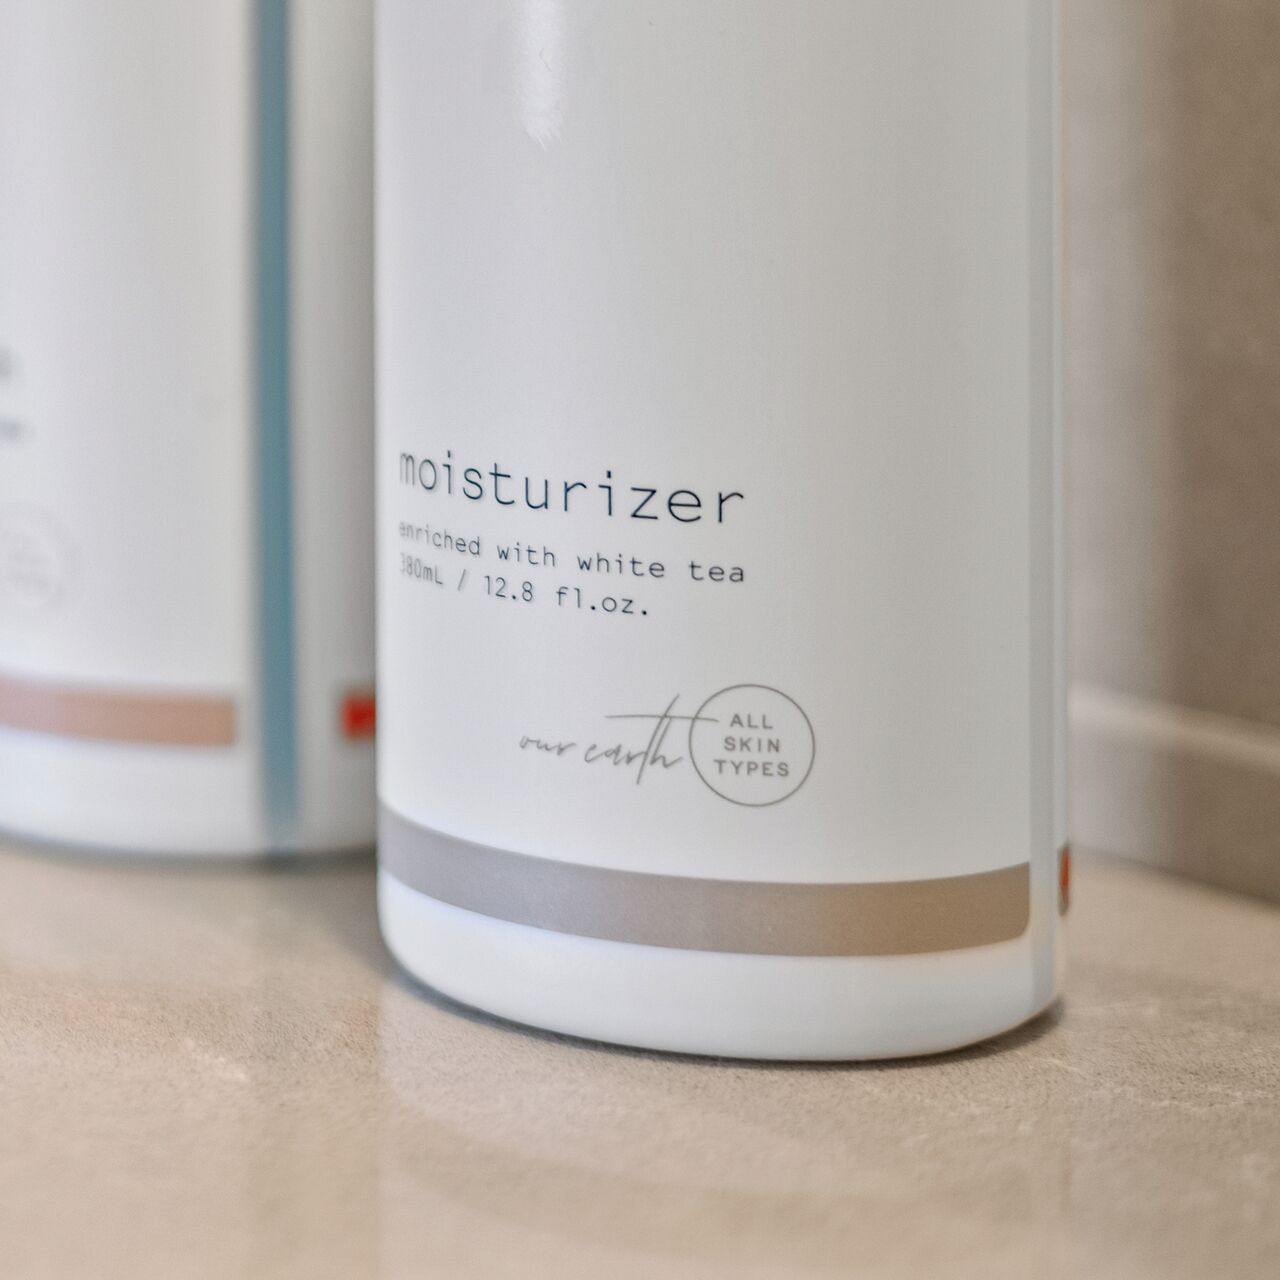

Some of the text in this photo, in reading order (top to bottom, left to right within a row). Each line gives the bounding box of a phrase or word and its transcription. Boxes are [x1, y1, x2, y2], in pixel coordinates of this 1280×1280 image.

[398, 450, 745, 523] moisturizer
[399, 521, 745, 584] enriched with white tea
[483, 575, 534, 603] 12.8
[556, 586, 649, 617] fl.oz.
[729, 714, 774, 730] ALL
[723, 736, 781, 754] SKIN
[713, 759, 790, 777] TYPES
